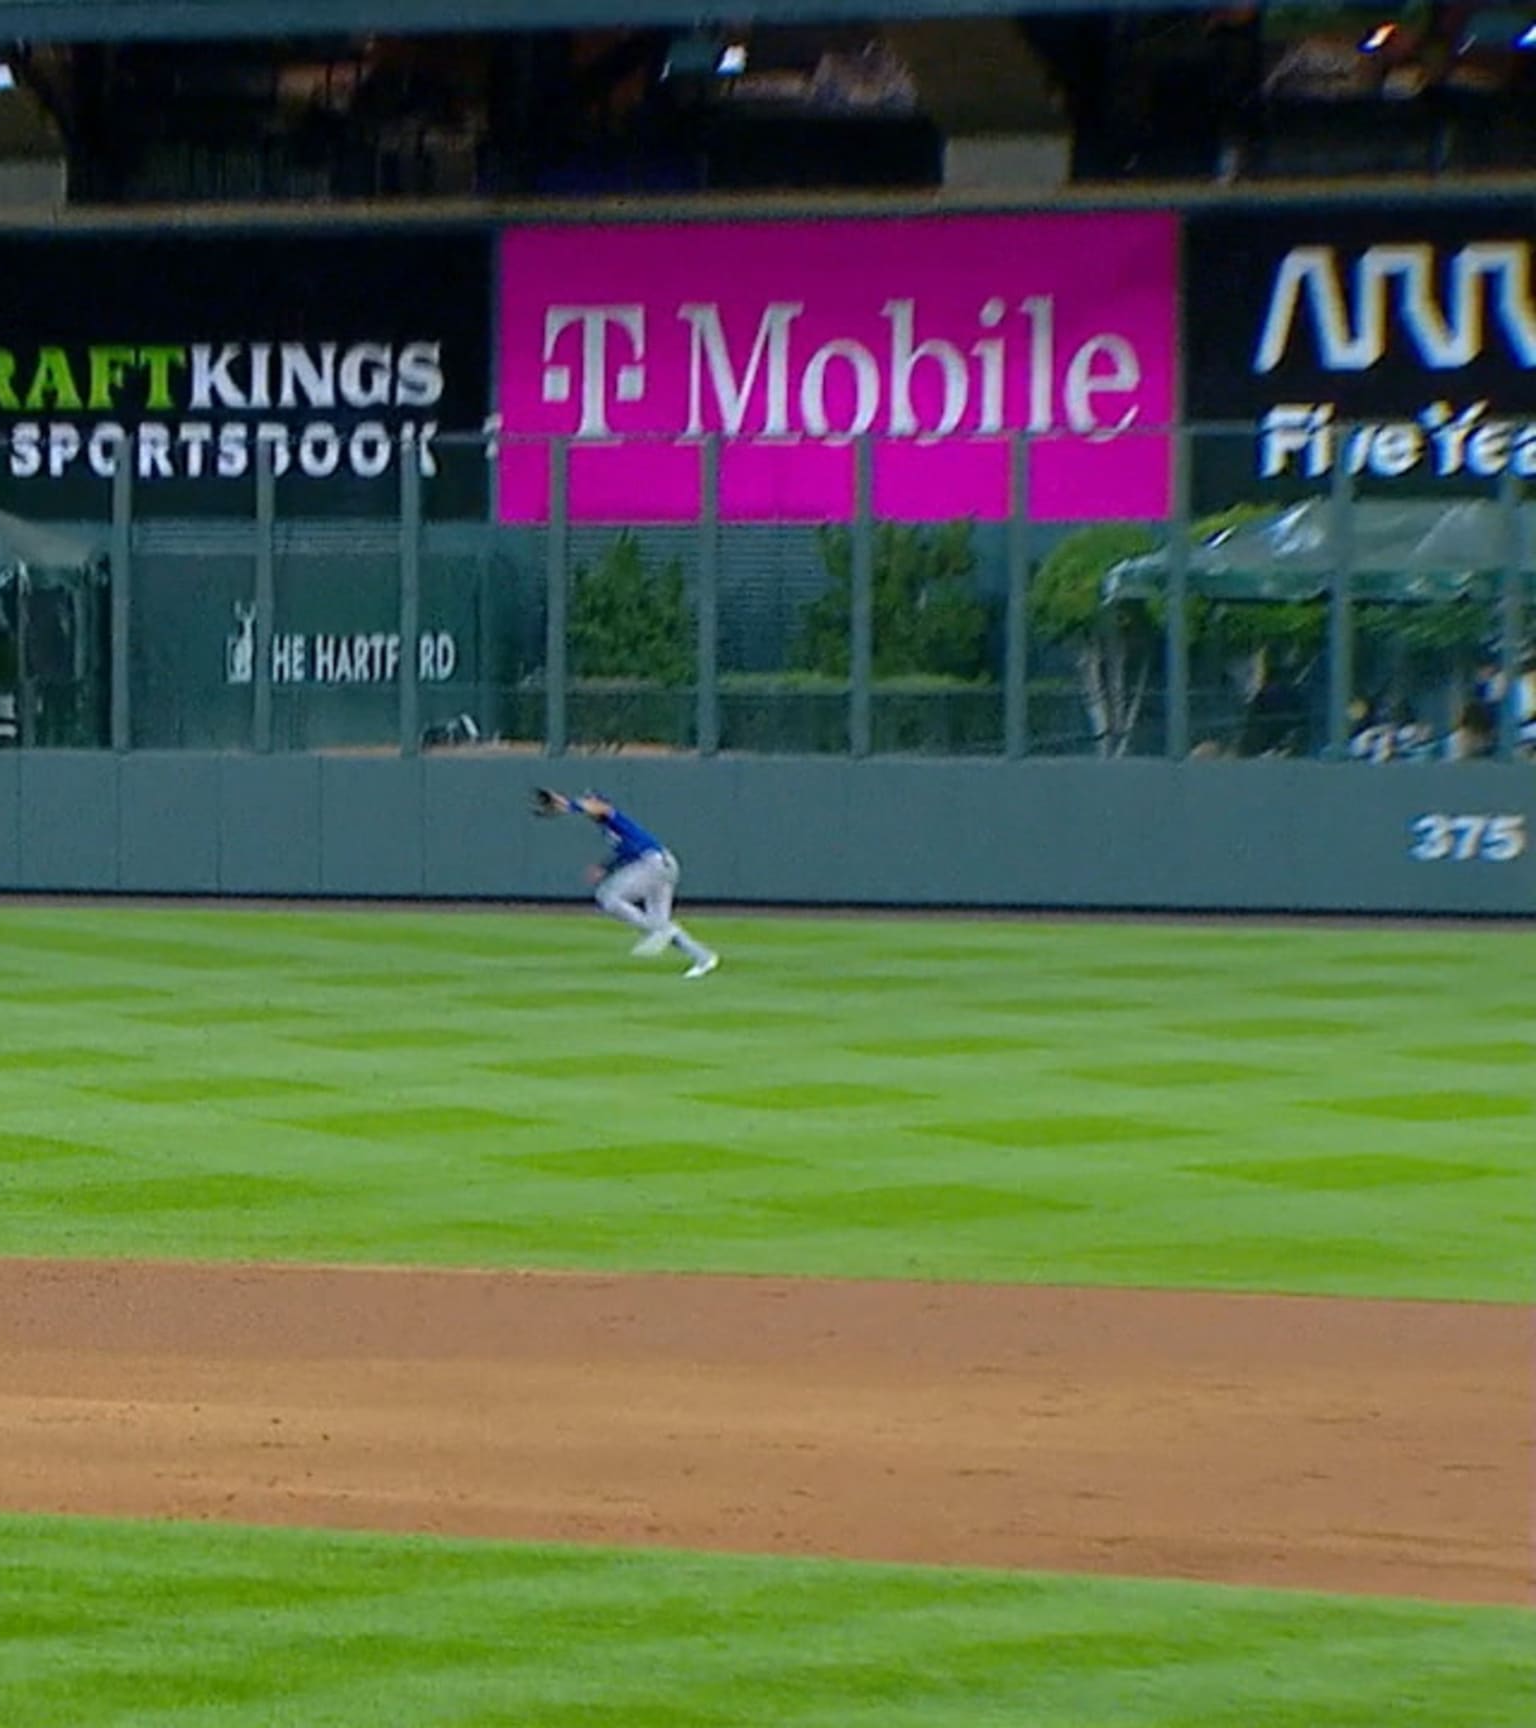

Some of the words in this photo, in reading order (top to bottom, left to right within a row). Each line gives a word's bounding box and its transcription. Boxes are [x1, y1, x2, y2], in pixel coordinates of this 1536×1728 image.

[676, 293, 1143, 446] Mobile
[272, 633, 306, 684] HE
[315, 632, 456, 684] HARTFRD
[1412, 814, 1526, 862] 375
